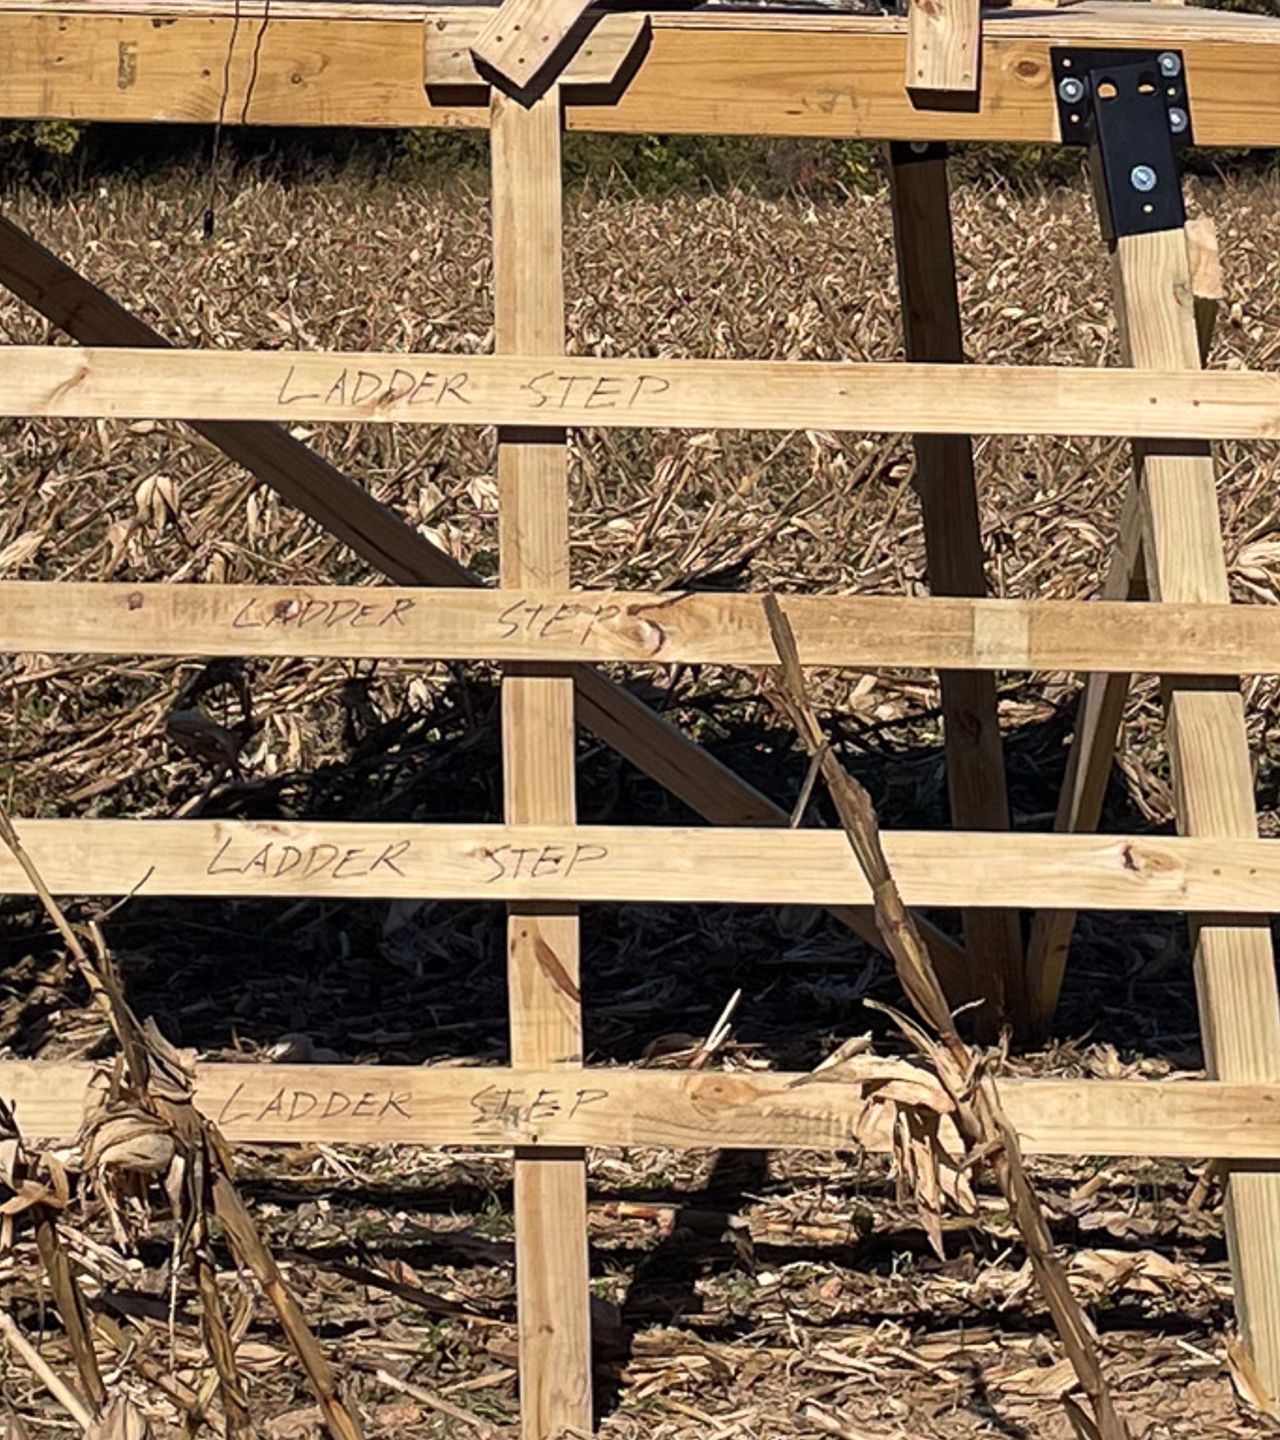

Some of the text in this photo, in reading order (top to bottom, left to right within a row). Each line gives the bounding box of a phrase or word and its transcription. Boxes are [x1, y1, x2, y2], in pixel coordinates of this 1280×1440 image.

[276, 364, 672, 411] LADDER STEP
[231, 596, 418, 630] LADDER
[497, 598, 621, 647] STEP
[206, 836, 609, 884] LADDER STEP
[218, 1081, 610, 1124] LADDER STEP
